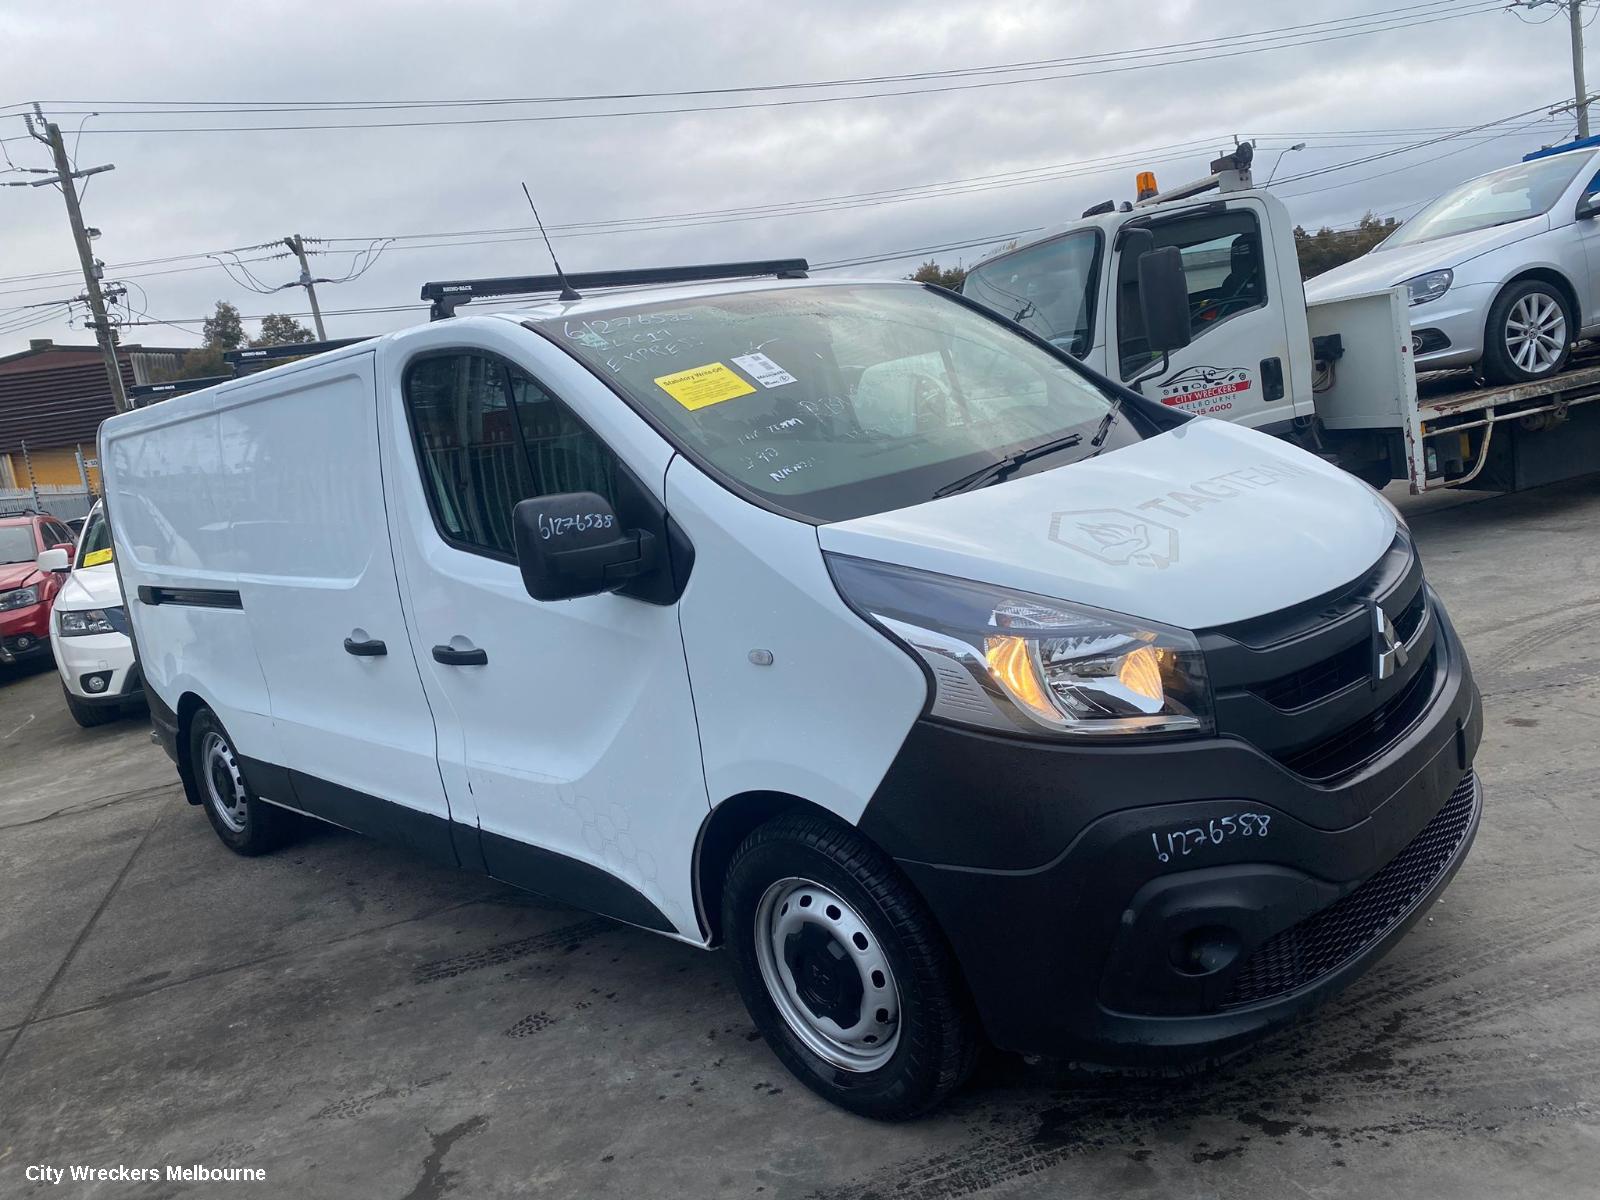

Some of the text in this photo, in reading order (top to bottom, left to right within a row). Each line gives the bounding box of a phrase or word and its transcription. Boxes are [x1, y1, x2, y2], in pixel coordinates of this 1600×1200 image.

[1175, 384, 1237, 404] CITY WRECKERS
[1208, 402, 1232, 412] 4000
[539, 513, 613, 539] 61276588
[1152, 813, 1271, 862] 61276588
